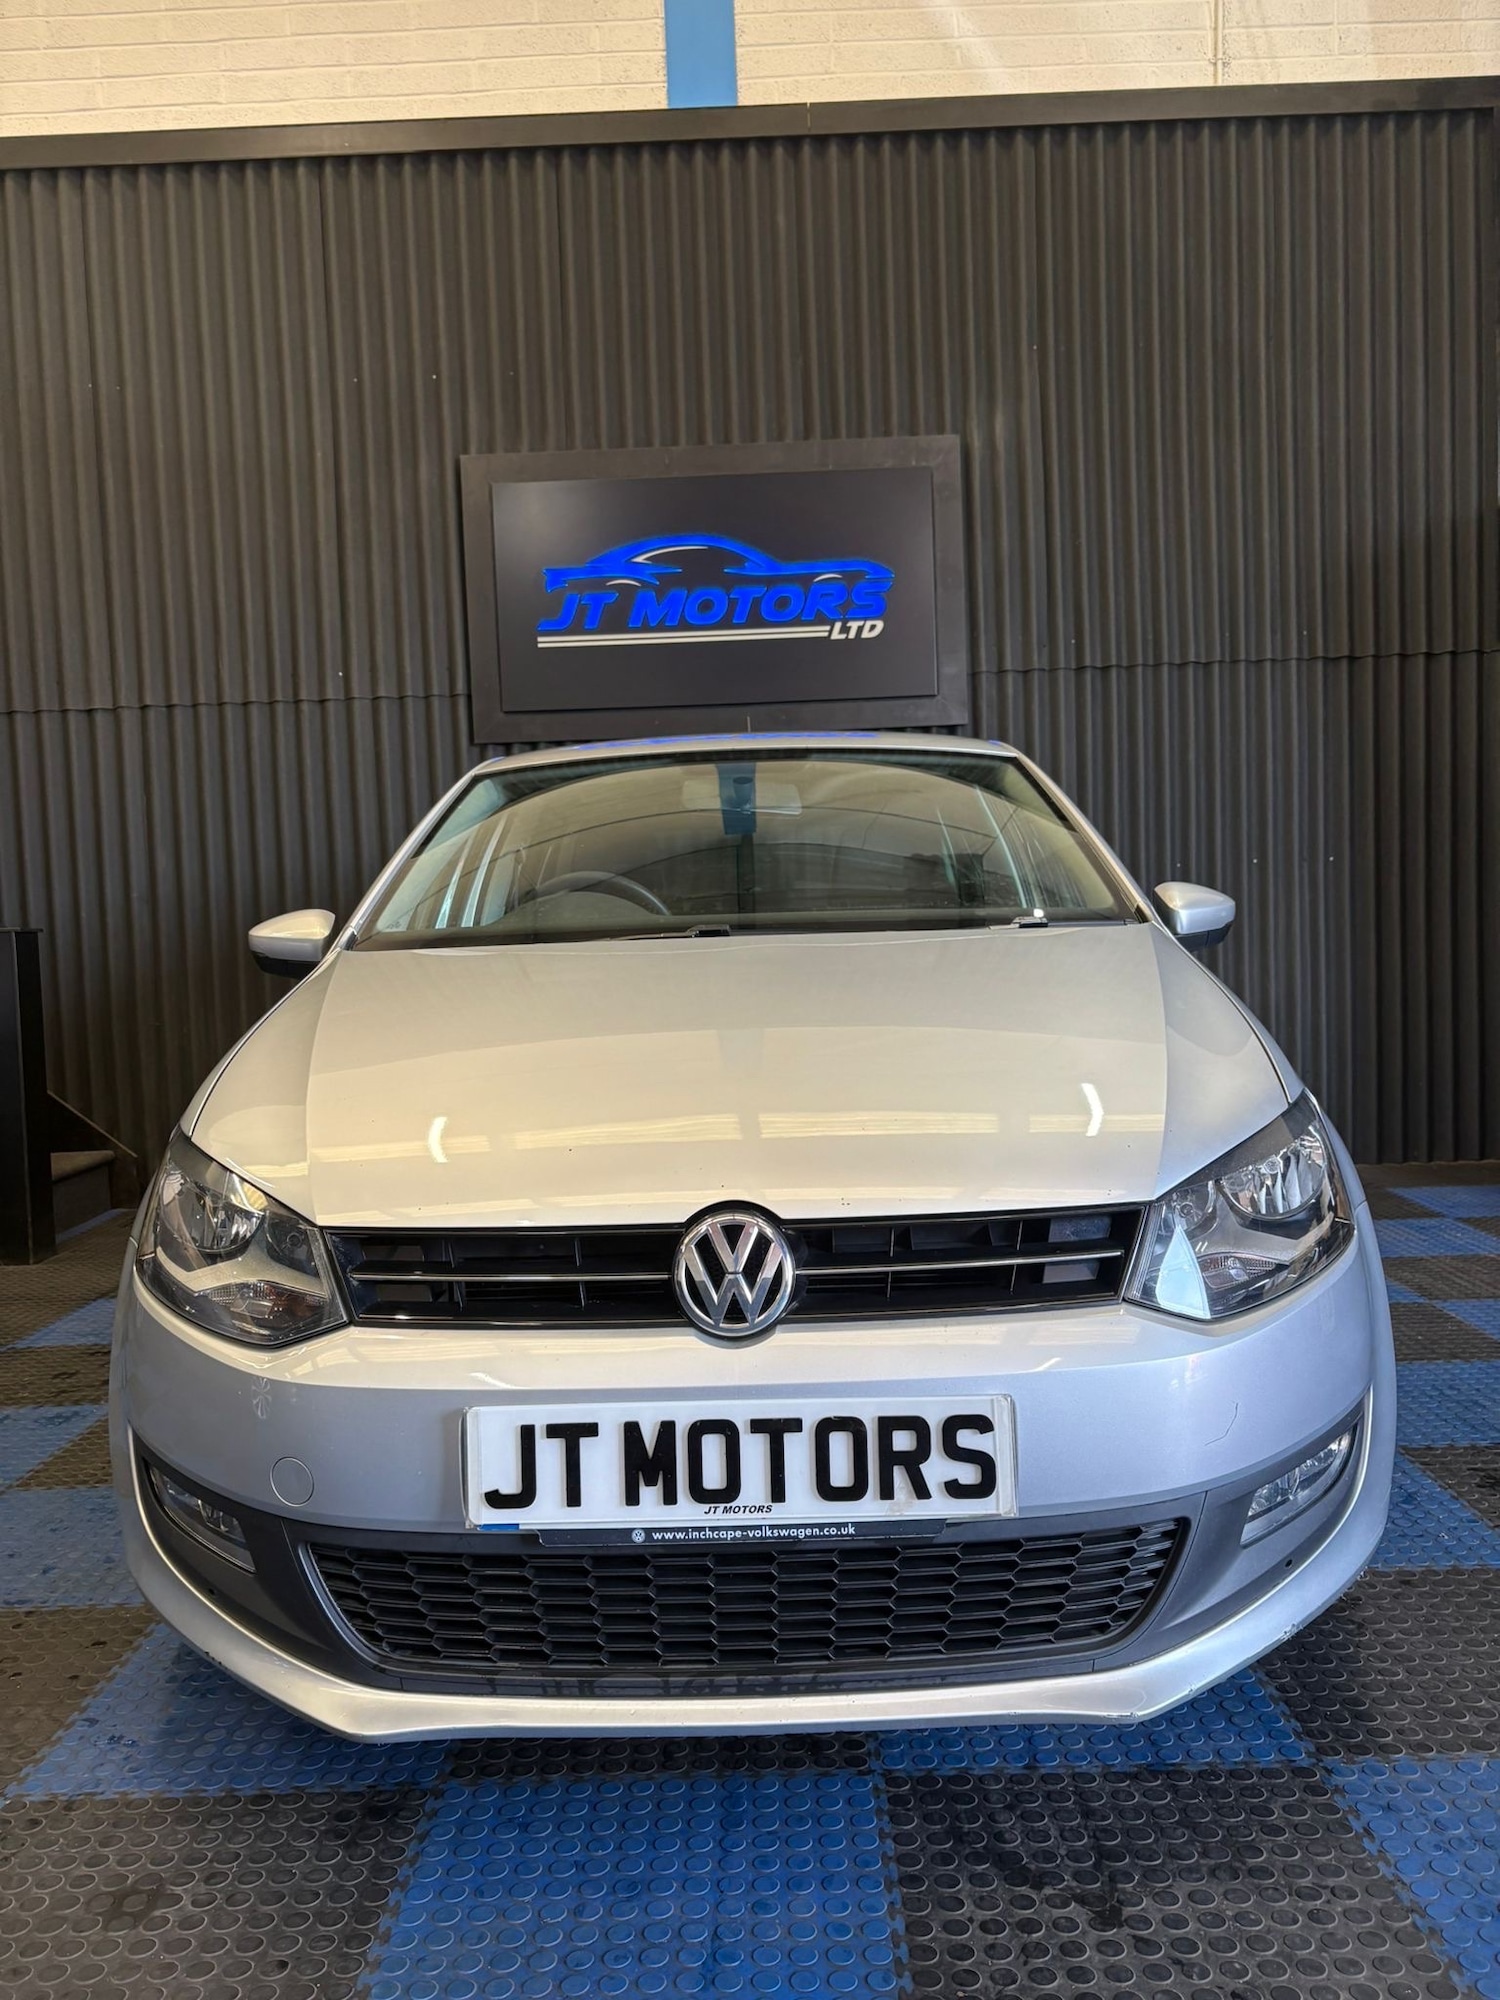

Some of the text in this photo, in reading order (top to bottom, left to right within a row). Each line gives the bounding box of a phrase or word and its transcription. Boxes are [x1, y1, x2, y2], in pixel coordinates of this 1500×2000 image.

[536, 581, 893, 631] JT MOTORS
[829, 619, 885, 641] LTD
[484, 1413, 998, 1509] JT MOTORS
[704, 1504, 773, 1515] JT MOTORS
[652, 1523, 856, 1541] www.inchcape-volkswagen.co.uk
